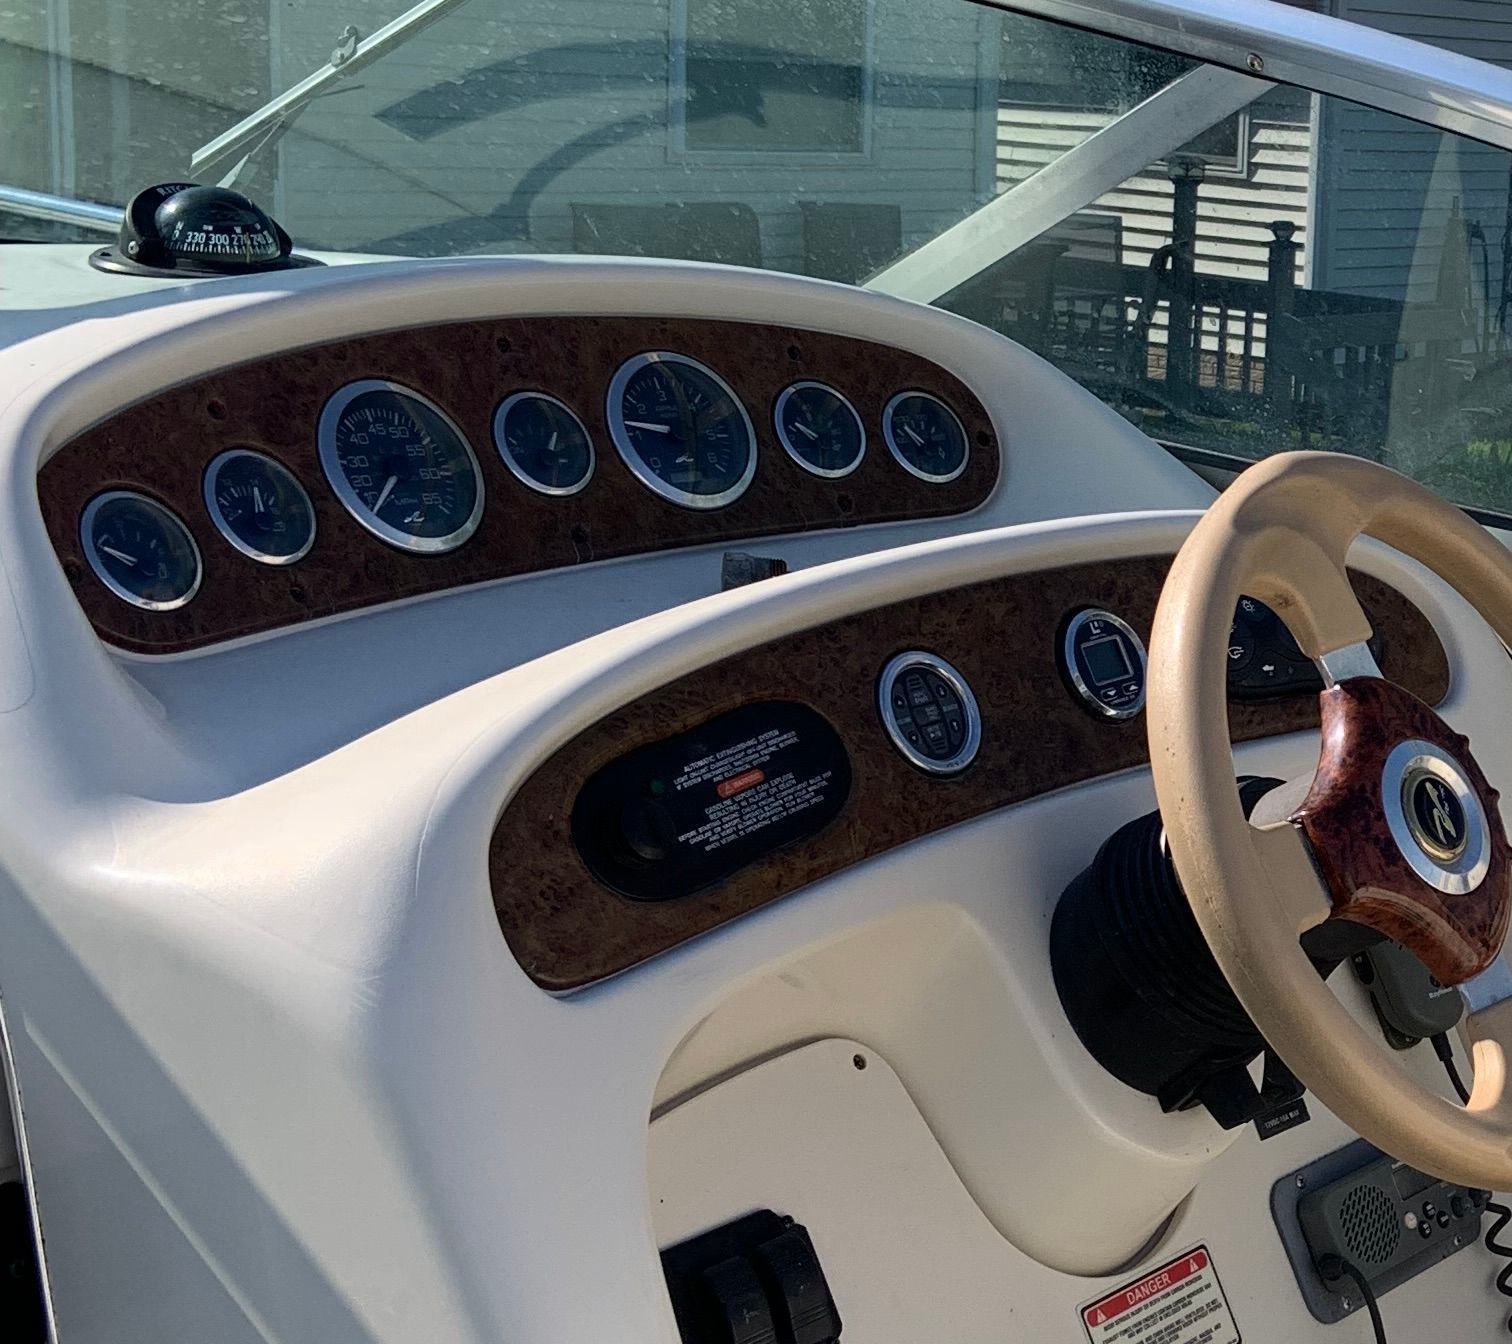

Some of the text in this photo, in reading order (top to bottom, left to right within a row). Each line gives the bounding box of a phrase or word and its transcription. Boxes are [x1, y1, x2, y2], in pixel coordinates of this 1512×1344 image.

[185, 232, 206, 243] 330
[208, 234, 229, 245] 300
[368, 423, 387, 435] 45
[389, 426, 409, 438] 50
[350, 433, 369, 445] 40
[406, 445, 426, 456] 55
[349, 456, 369, 467] 30
[420, 468, 440, 479] 60
[351, 475, 372, 486] 20
[1126, 1273, 1172, 1305] DANGER
